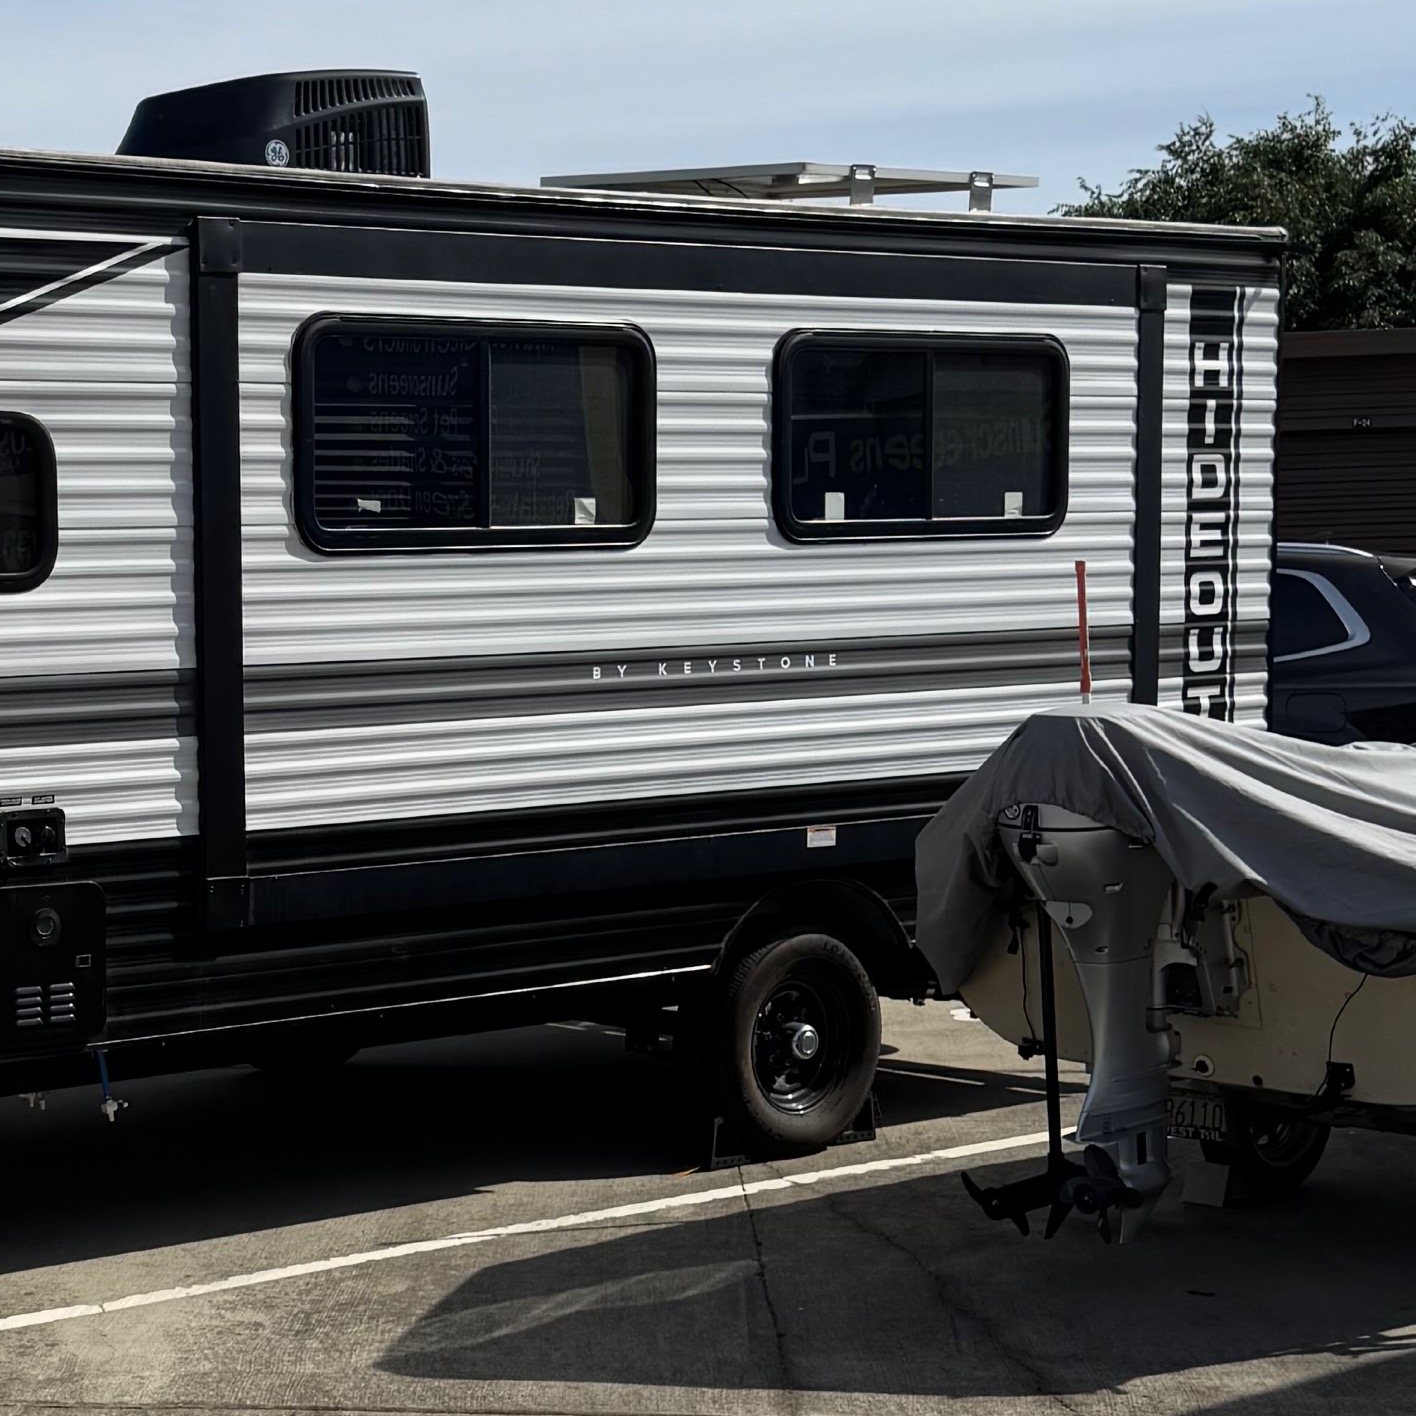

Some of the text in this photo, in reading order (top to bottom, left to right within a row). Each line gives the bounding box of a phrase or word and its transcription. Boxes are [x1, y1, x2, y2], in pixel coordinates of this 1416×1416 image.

[1188, 341, 1230, 719] HIDEOUT
[592, 653, 840, 679] BY KEYSTONE
[1166, 1125, 1195, 1138] EST
